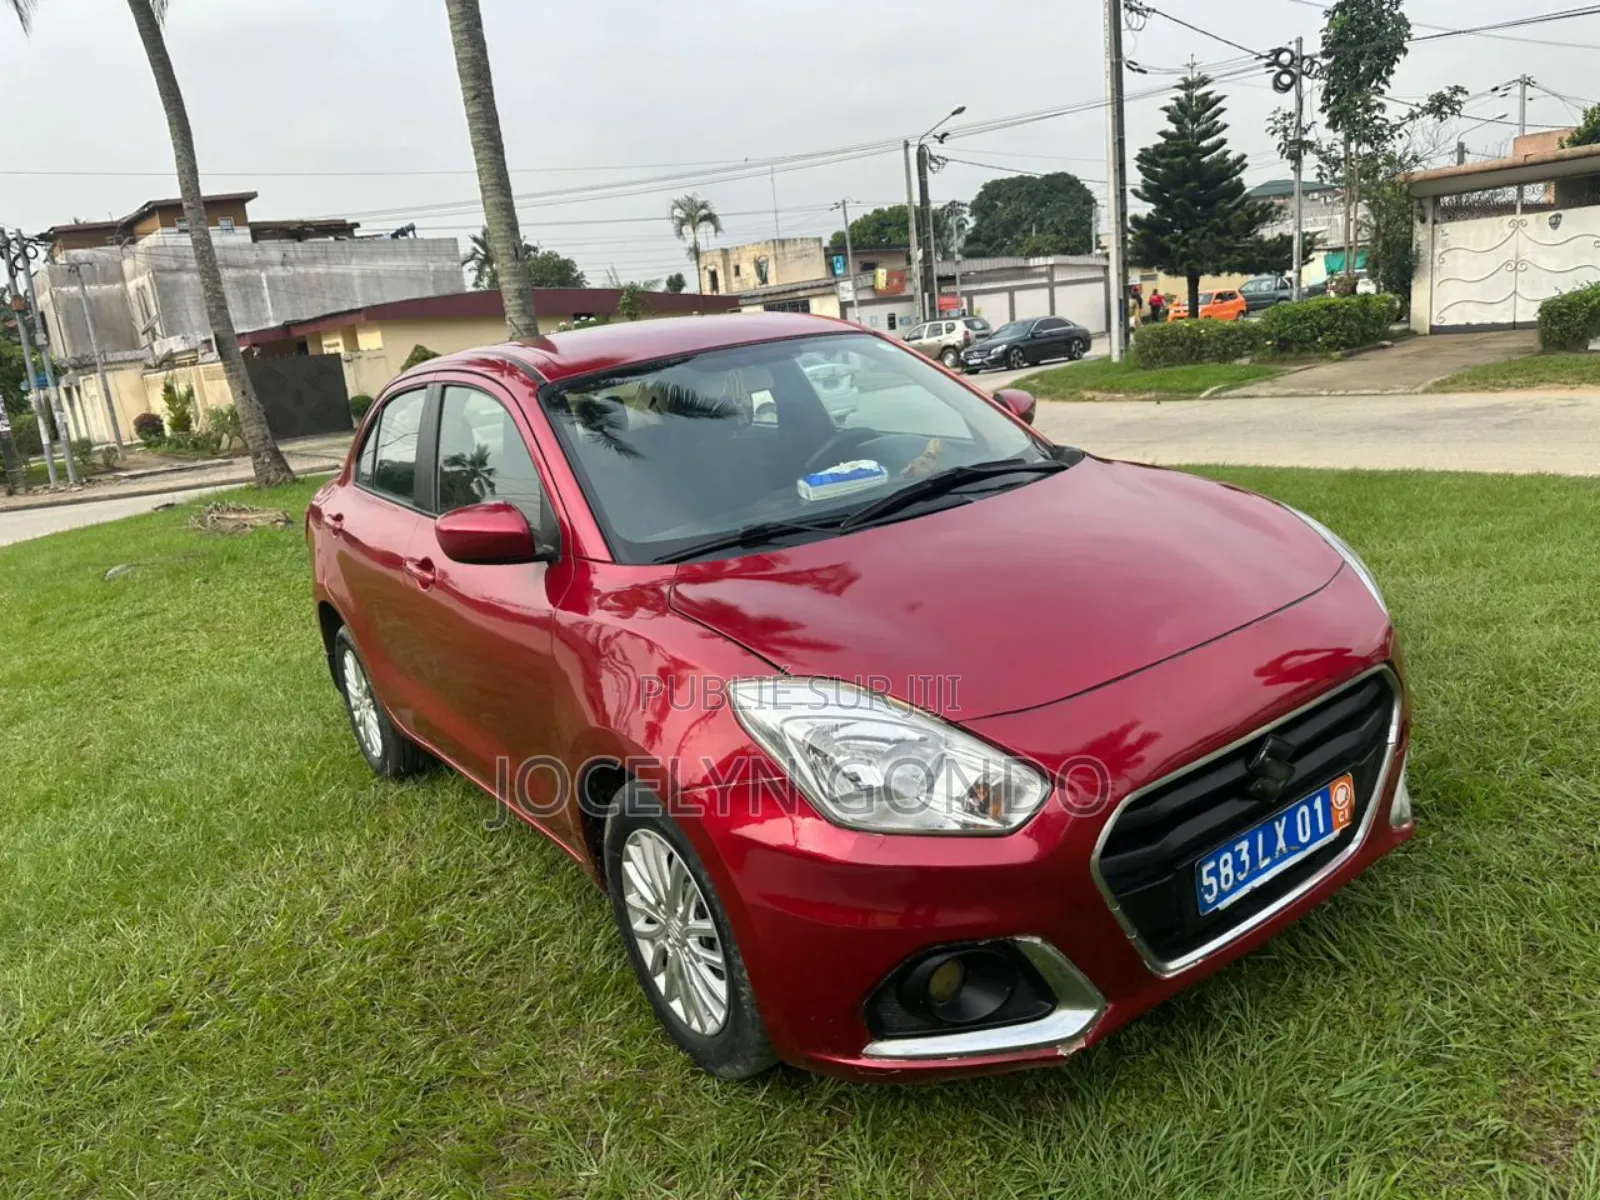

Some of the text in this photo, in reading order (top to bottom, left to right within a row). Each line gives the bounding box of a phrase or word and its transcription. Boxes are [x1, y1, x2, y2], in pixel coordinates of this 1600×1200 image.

[1202, 795, 1325, 905] 583 LX 01
